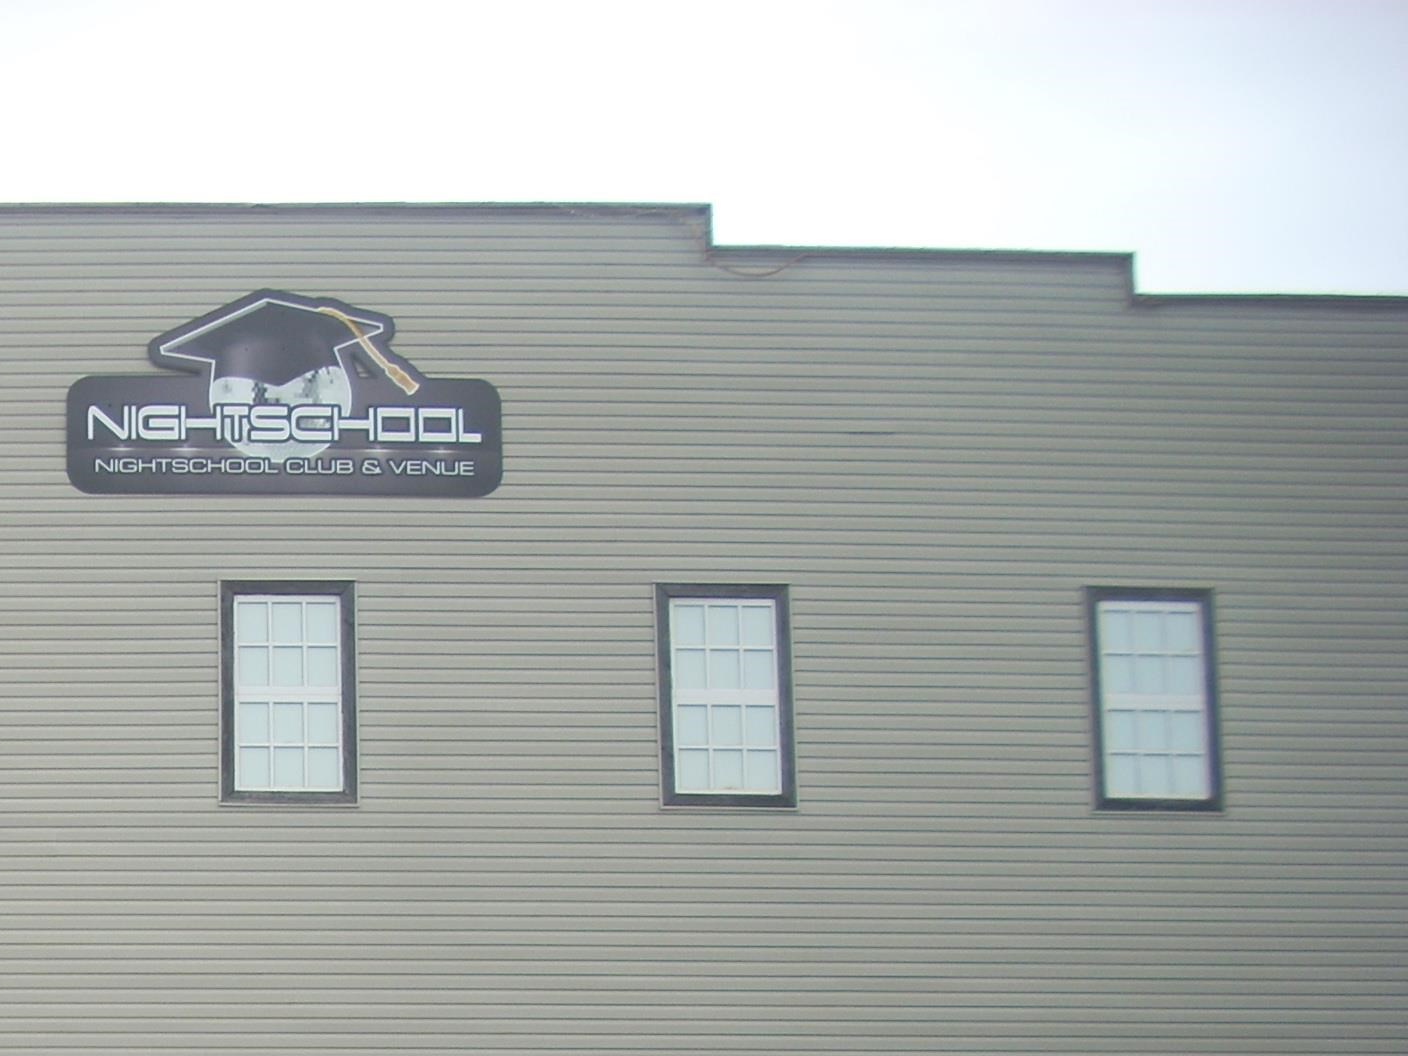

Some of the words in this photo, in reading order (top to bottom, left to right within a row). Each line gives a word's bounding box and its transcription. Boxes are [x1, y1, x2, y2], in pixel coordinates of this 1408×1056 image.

[87, 405, 482, 443] NIGHTSCHOOL
[94, 458, 279, 474] NIGHTSCHOOL
[286, 459, 354, 474] CLUB
[362, 460, 382, 475] &
[389, 461, 475, 476] VENUE
